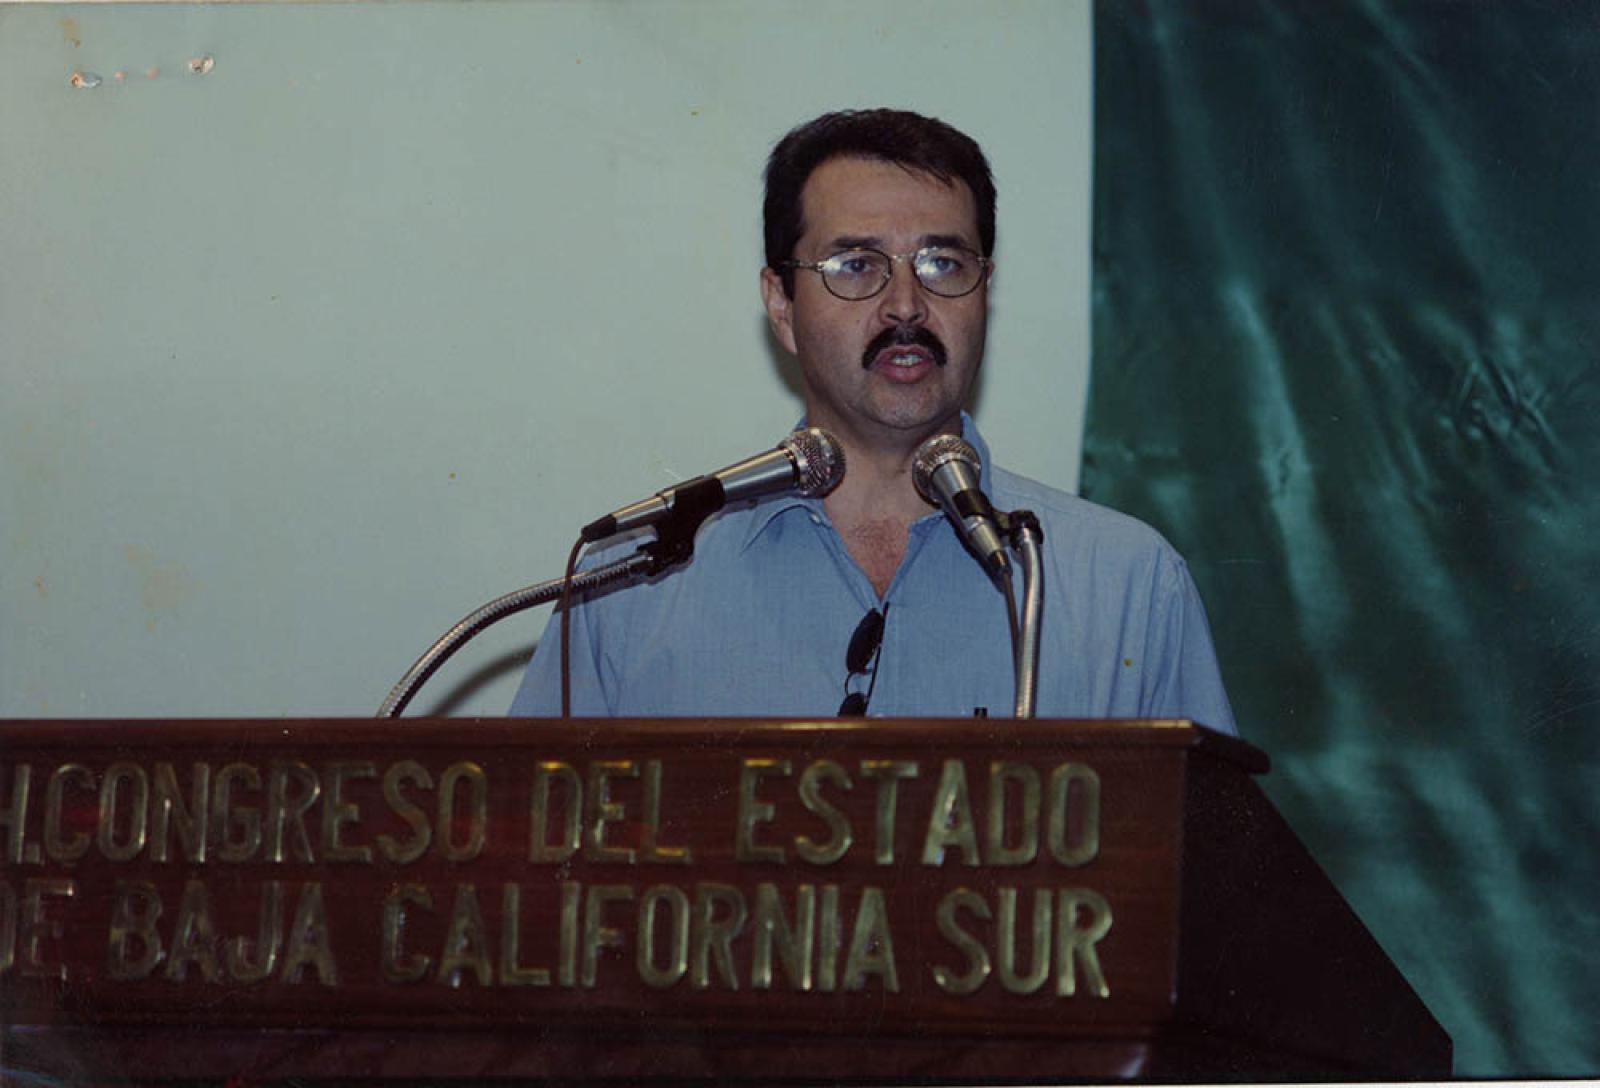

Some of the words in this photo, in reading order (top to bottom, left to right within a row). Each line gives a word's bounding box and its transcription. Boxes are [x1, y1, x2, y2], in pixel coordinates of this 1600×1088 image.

[529, 759, 692, 865] DEL
[736, 758, 1100, 866] ESTADO
[109, 878, 338, 986] BAJA
[383, 880, 900, 992] CALIFORNIA
[932, 886, 1113, 998] SUR
